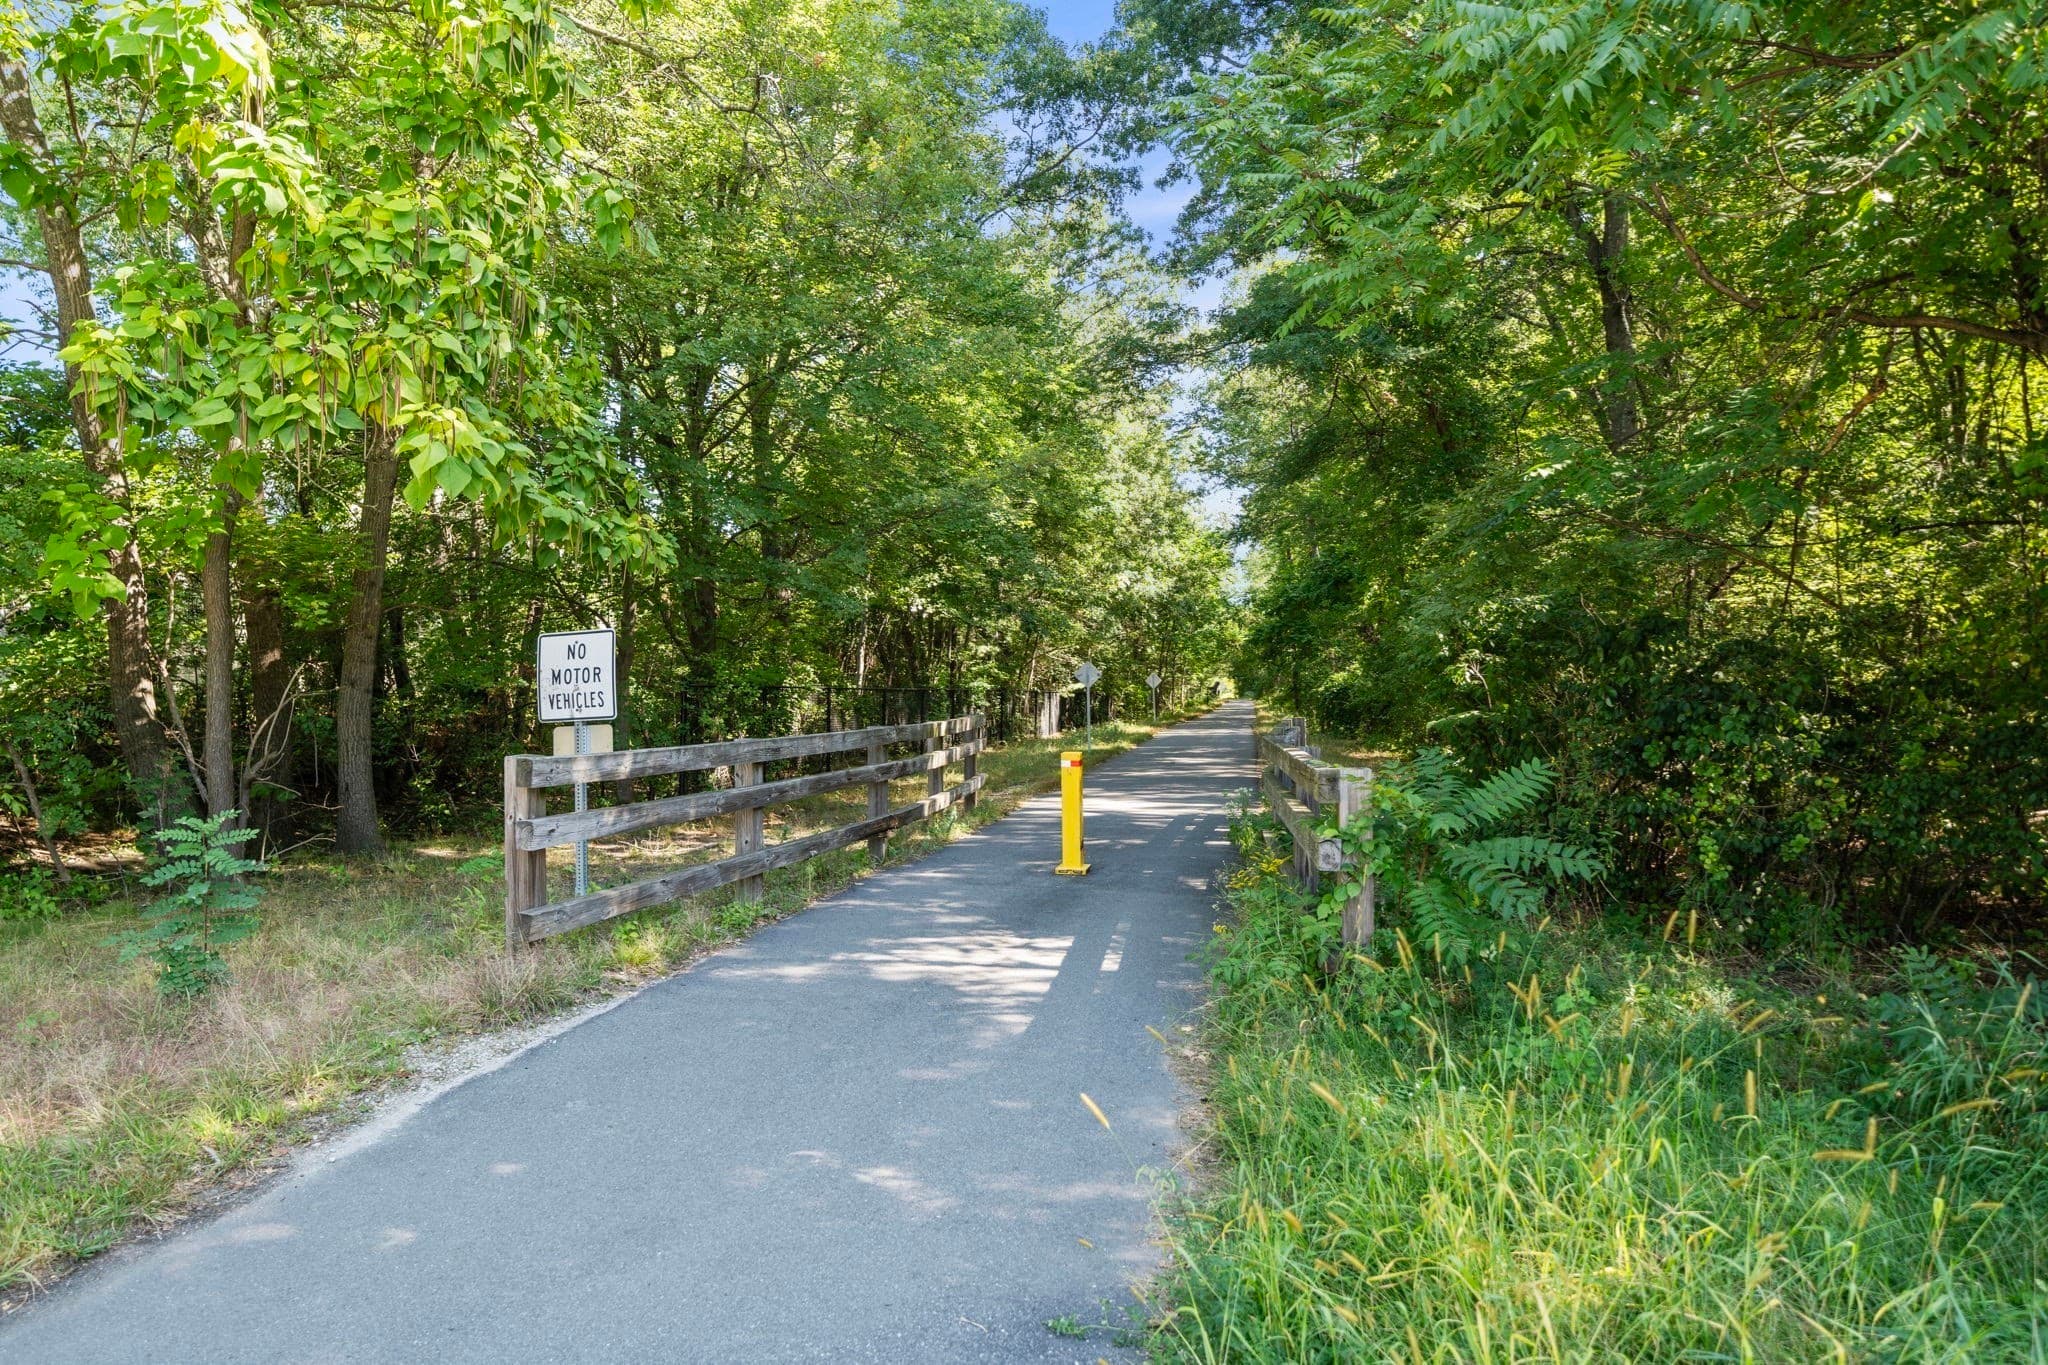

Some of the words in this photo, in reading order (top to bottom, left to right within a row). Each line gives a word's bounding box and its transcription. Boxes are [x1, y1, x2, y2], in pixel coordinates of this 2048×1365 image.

[567, 643, 586, 660] NO
[551, 666, 601, 685] MOTOR
[548, 691, 605, 710] VEHICLES
